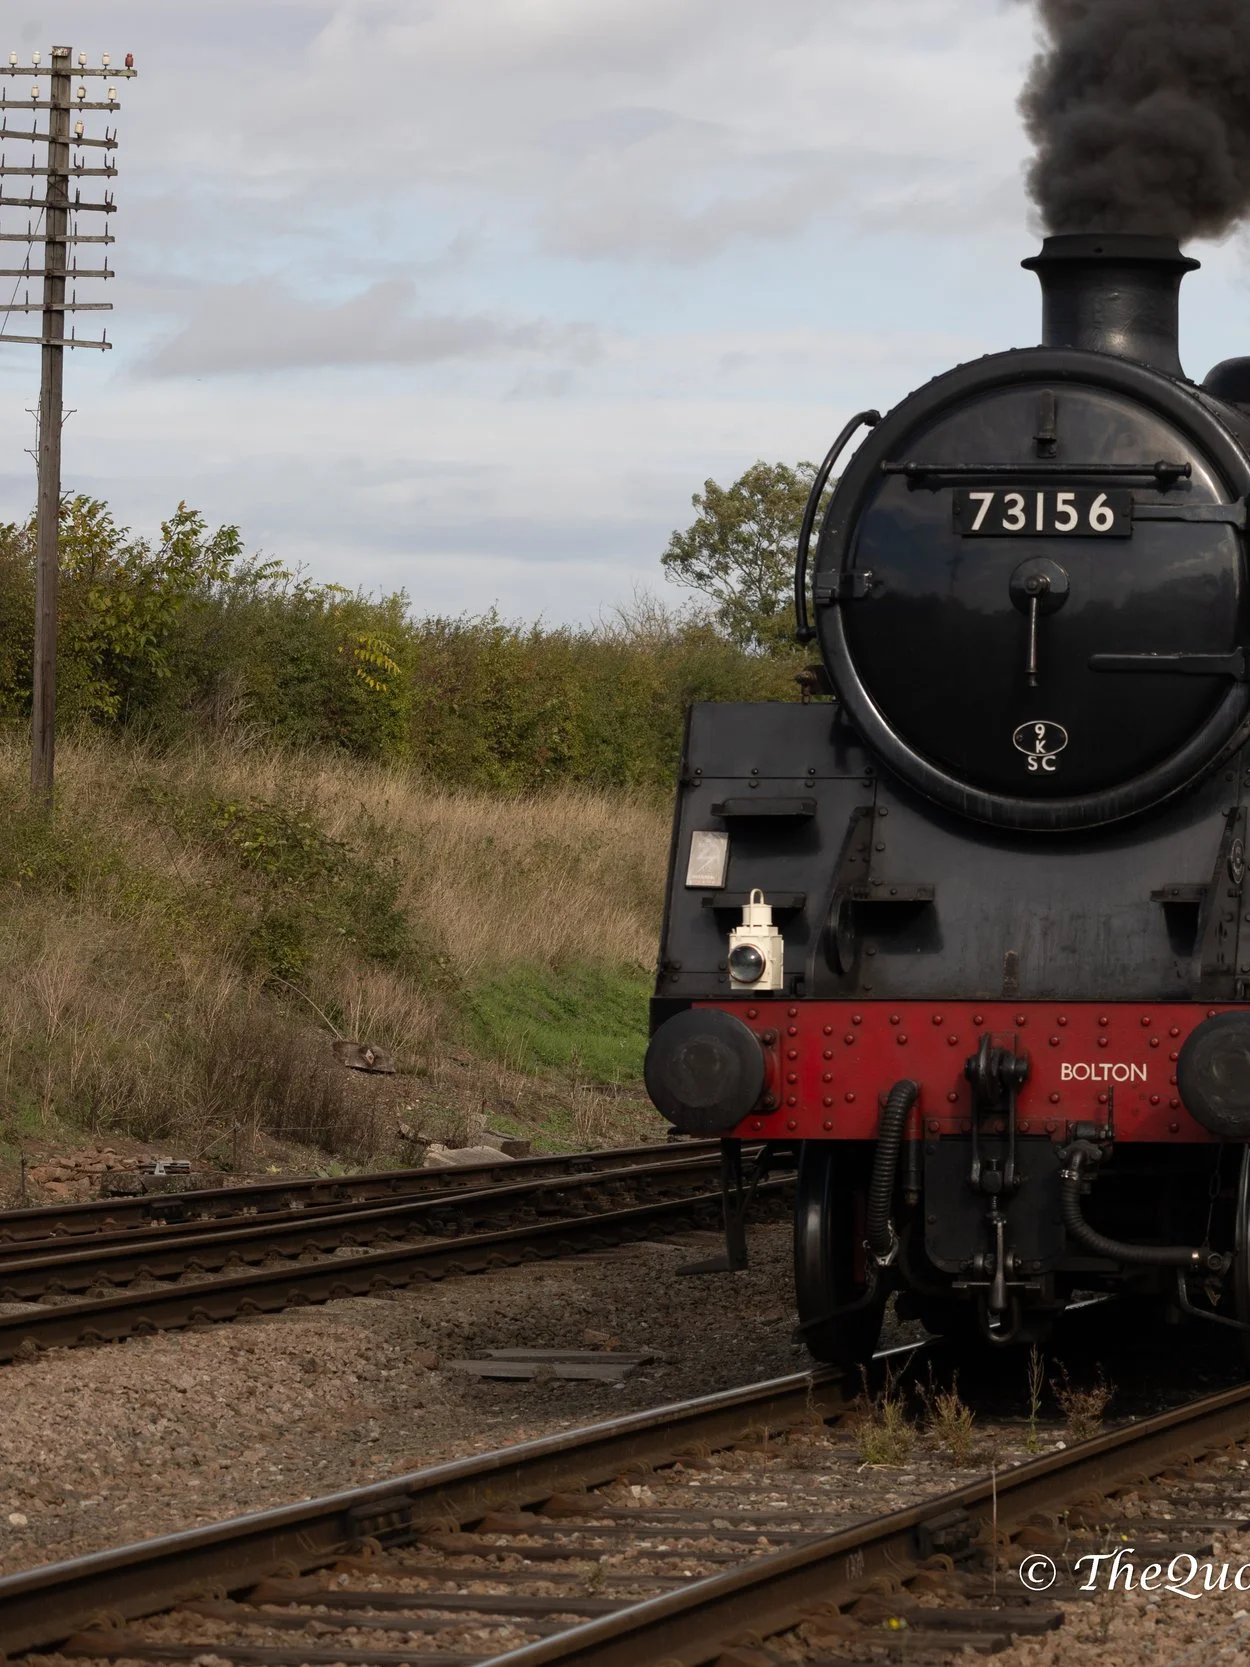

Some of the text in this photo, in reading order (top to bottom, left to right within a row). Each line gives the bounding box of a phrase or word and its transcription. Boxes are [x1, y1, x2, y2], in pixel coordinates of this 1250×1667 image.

[969, 492, 1114, 532] 73156
[1034, 723, 1045, 739] 9
[1035, 740, 1046, 753] K
[1027, 755, 1056, 771] SC
[1061, 1063, 1147, 1081] BOLTON
